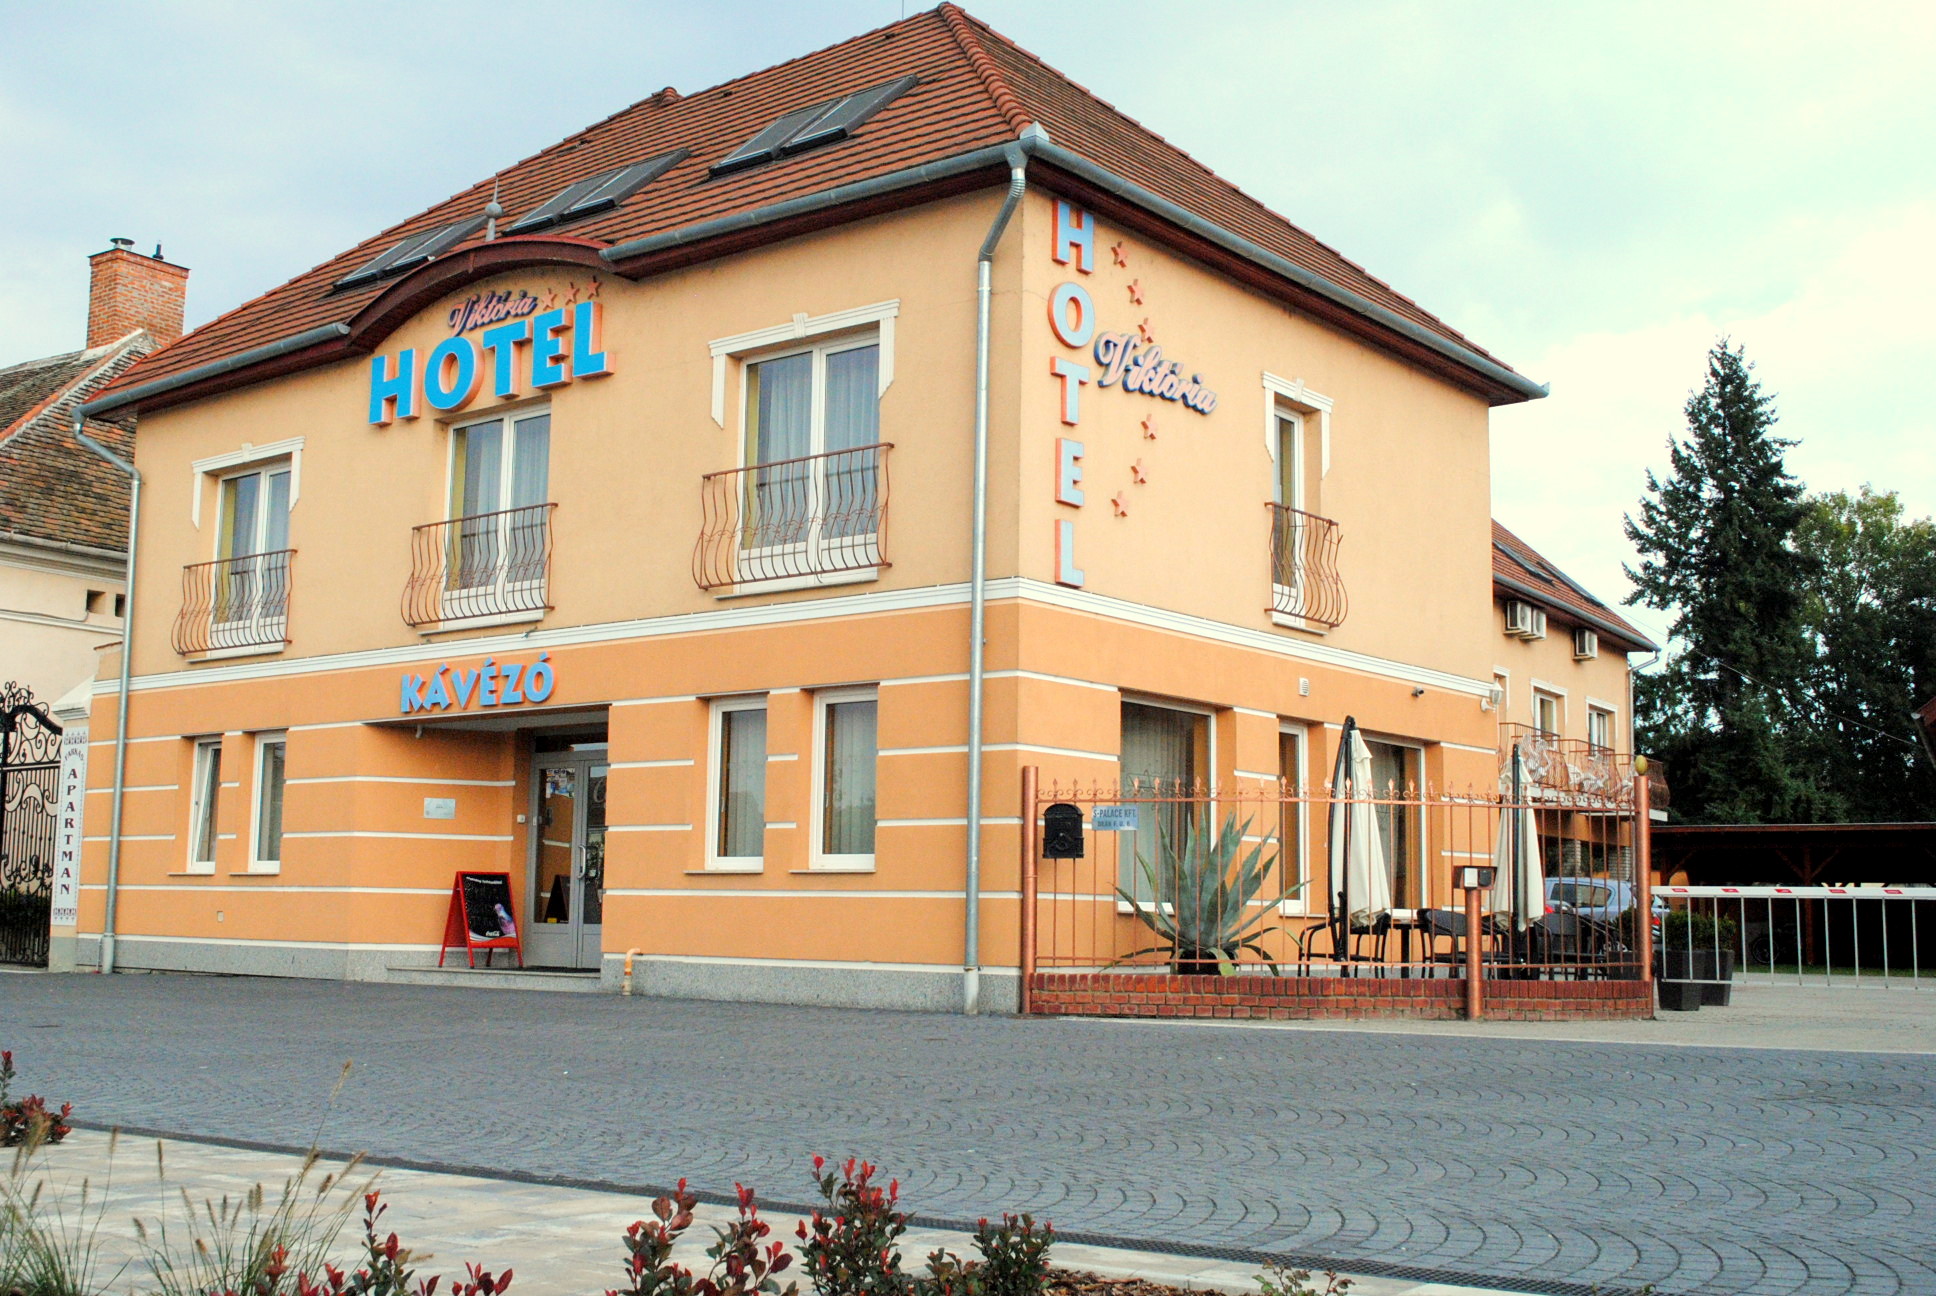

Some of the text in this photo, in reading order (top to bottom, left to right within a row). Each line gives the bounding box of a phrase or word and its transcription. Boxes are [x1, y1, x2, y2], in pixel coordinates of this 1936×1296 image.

[448, 289, 538, 337] Viktória
[368, 300, 614, 426] HOTEL
[1048, 200, 1095, 588] HOTEL
[1094, 331, 1217, 415] Viktória
[401, 651, 557, 712] KÁVÉZÓ
[60, 768, 78, 895] APARTMAN
[1093, 808, 1123, 818] S-PALACE
